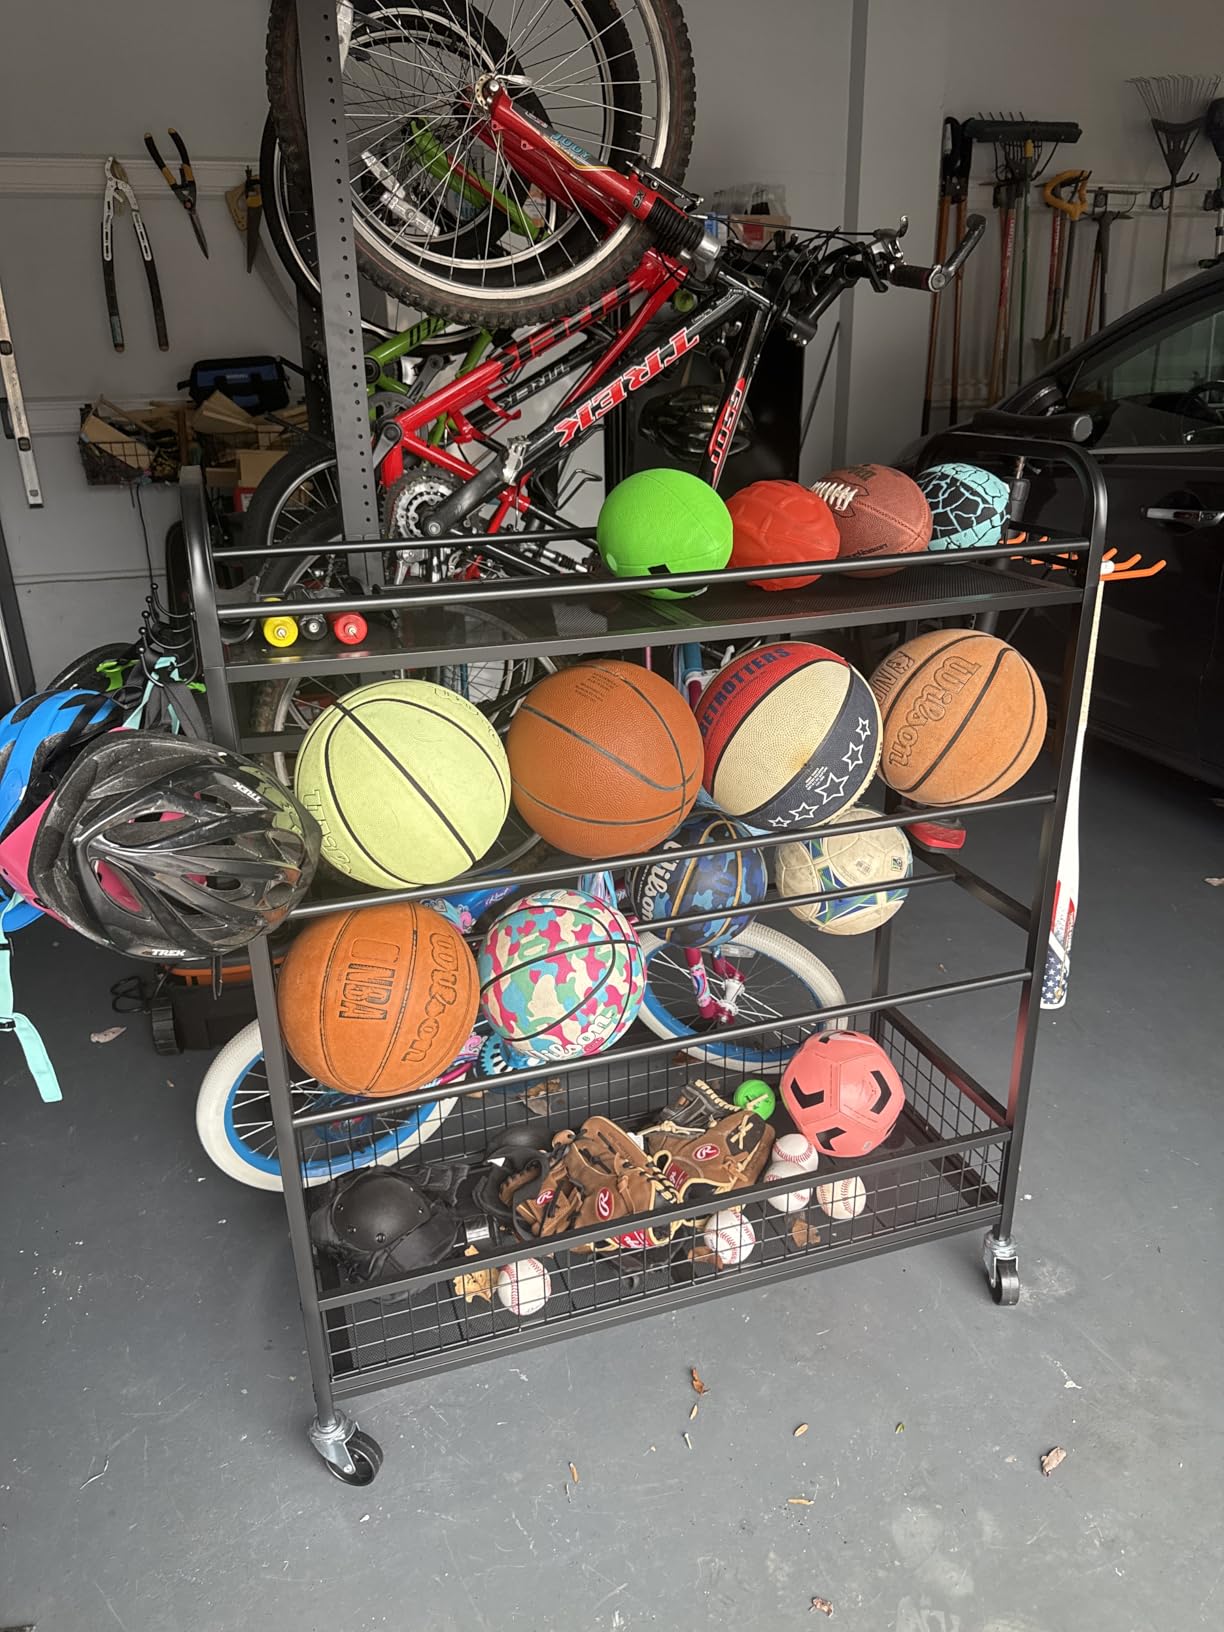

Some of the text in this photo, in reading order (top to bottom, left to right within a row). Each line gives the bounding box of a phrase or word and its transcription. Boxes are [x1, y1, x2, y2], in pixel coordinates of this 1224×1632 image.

[550, 132, 592, 160] JUDY
[632, 189, 647, 209] XC
[554, 326, 700, 448] TREK
[699, 647, 791, 738] BETROTTERS
[889, 655, 982, 768] Wilson
[232, 781, 262, 803] TREK
[151, 949, 187, 957] TREK
[338, 962, 396, 1021] NBA
[401, 932, 460, 1063] Wilson
